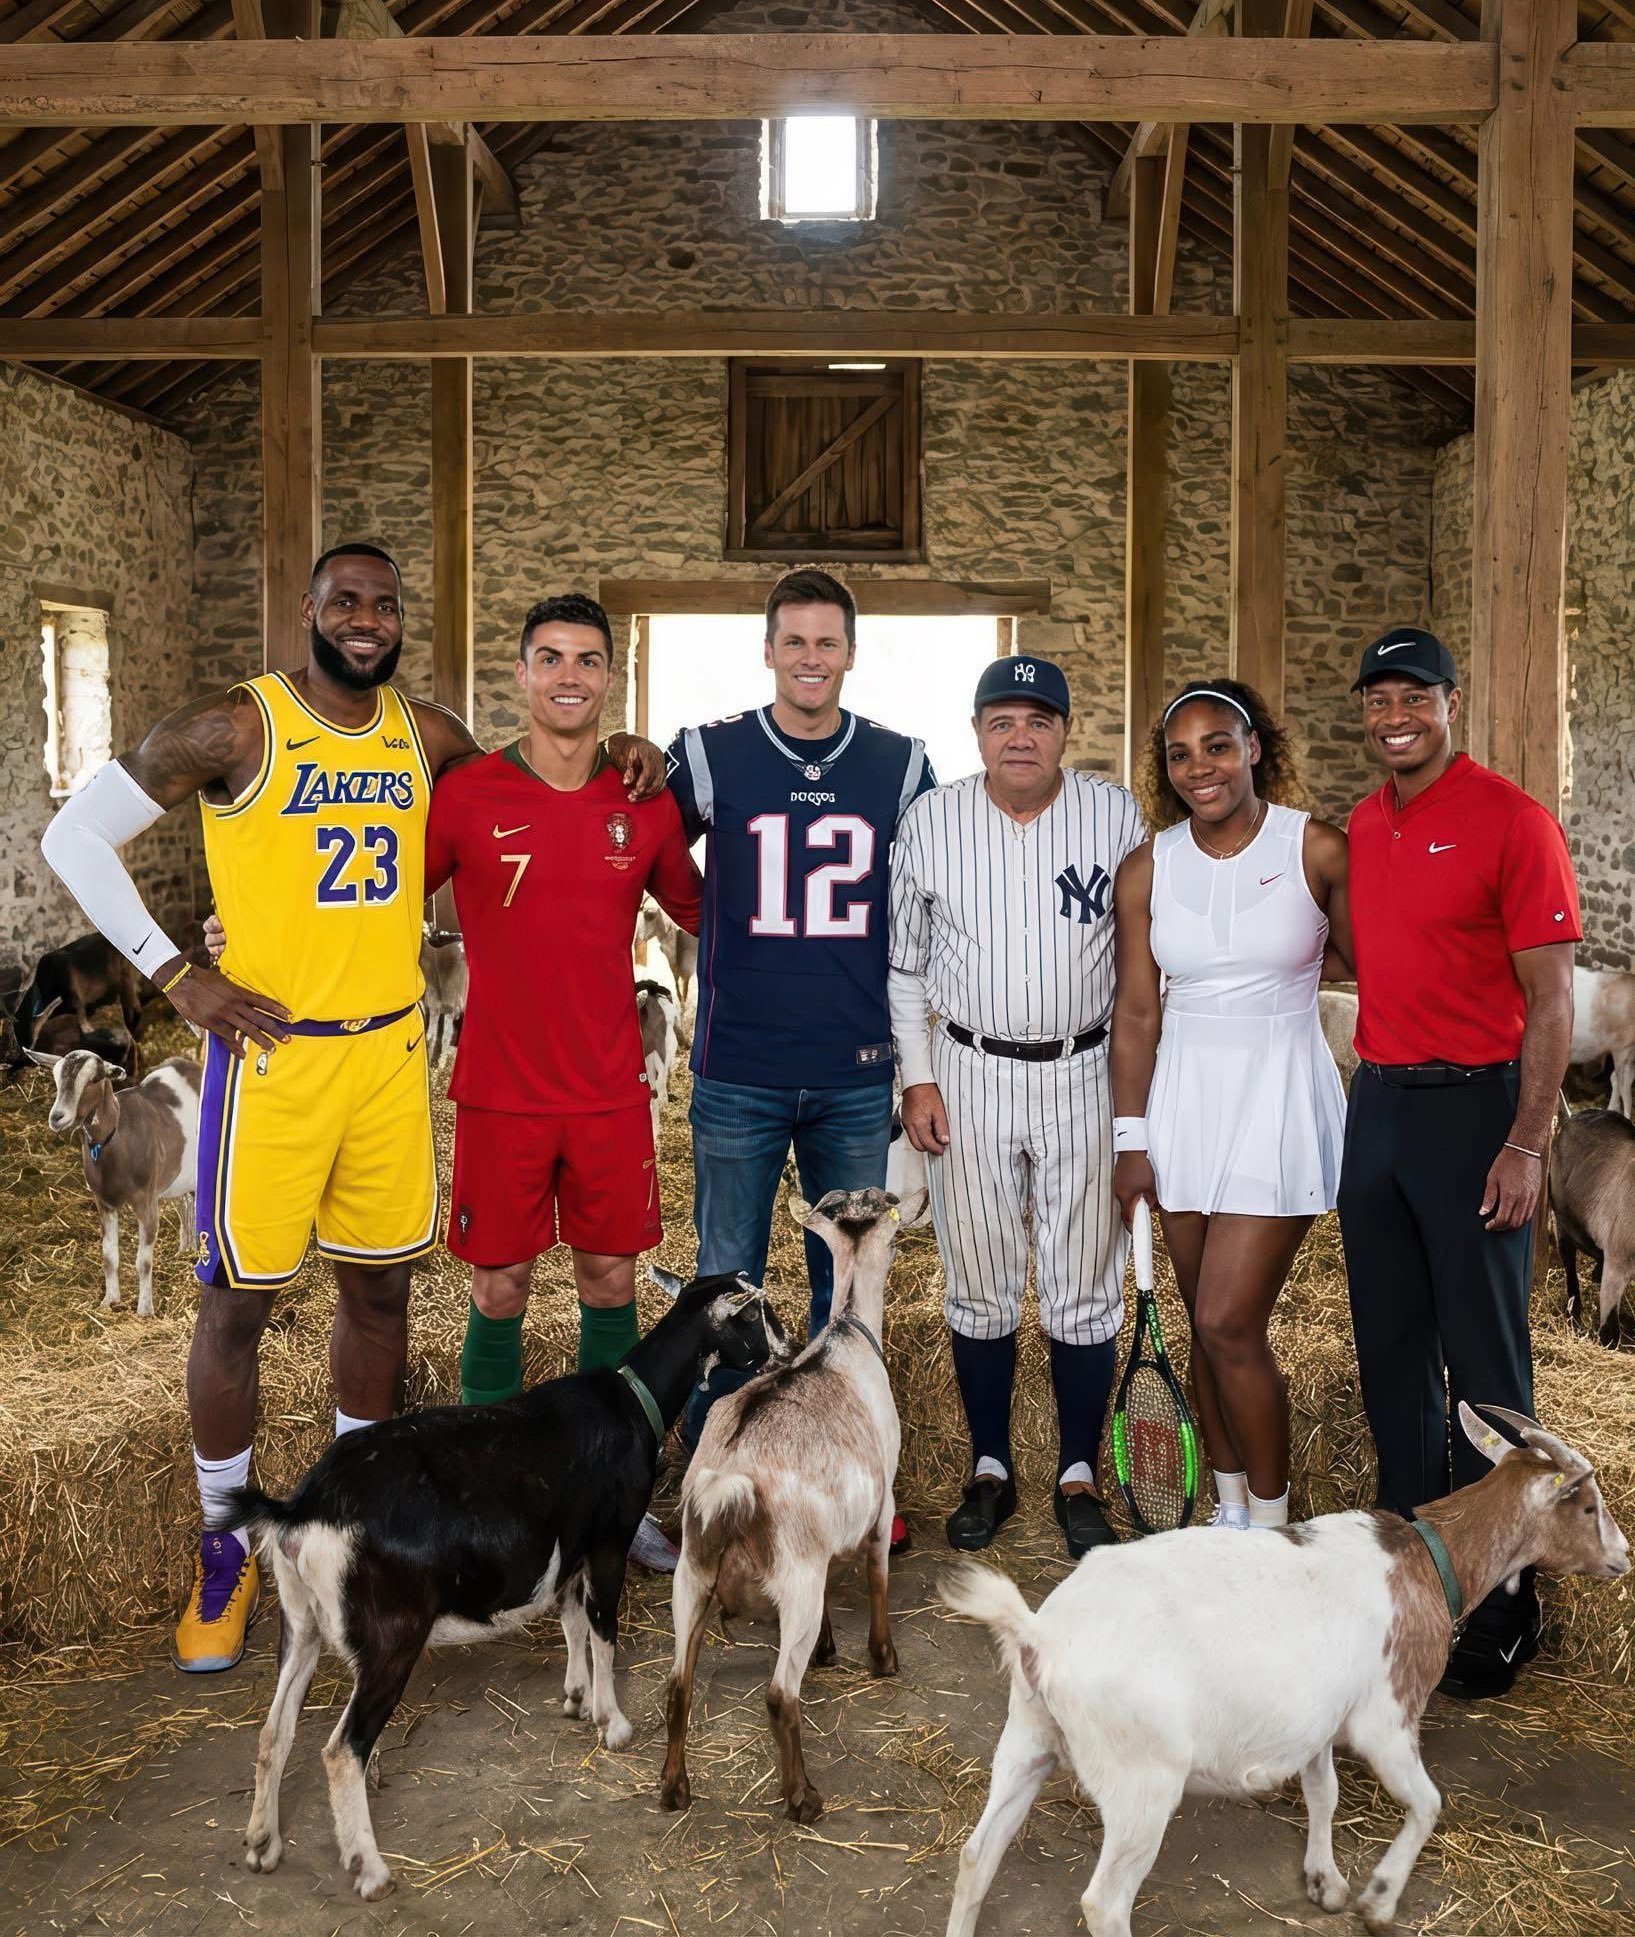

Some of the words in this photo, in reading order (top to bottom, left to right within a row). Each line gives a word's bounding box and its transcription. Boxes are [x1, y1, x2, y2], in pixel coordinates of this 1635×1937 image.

[280, 763, 415, 816] LAKERS
[316, 824, 400, 908] 23
[500, 854, 532, 908] 7
[746, 813, 876, 938] 12
[1054, 863, 1112, 925] NY
